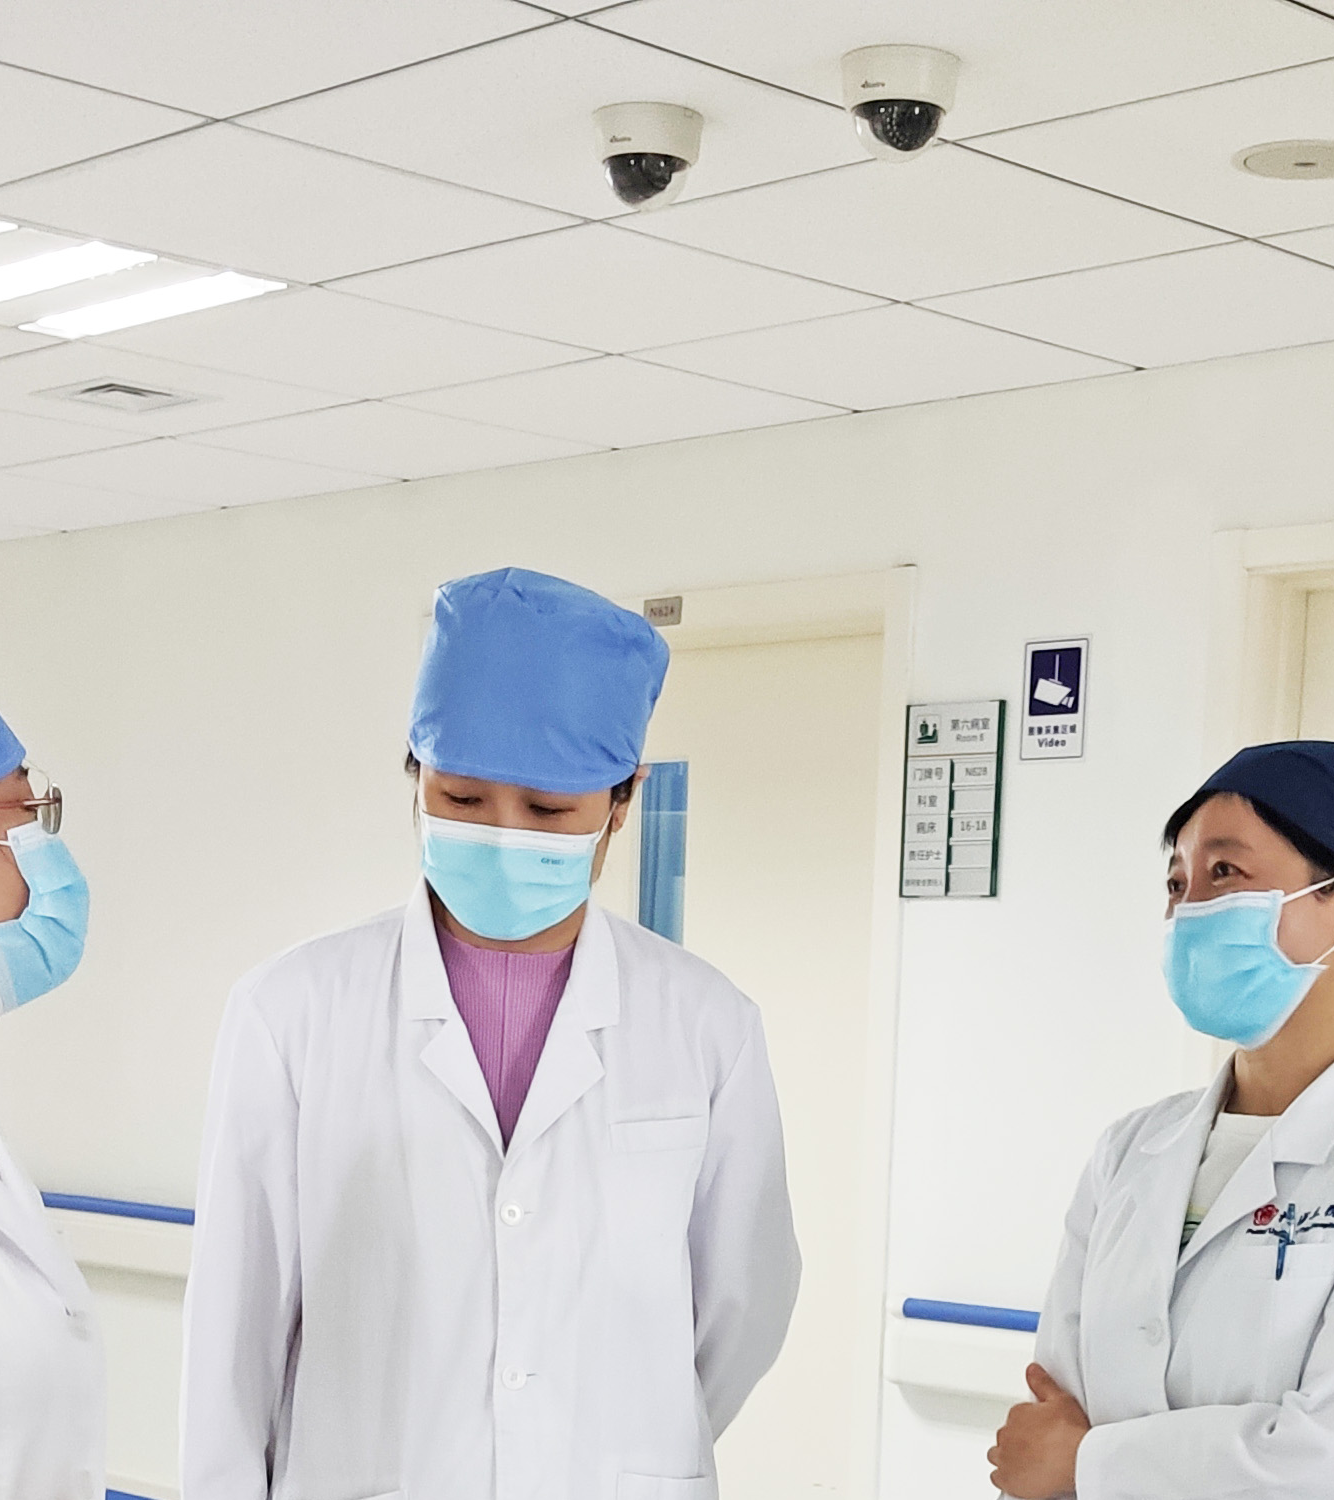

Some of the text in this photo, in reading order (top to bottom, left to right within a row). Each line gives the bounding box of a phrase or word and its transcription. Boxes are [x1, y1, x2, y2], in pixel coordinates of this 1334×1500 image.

[956, 734, 978, 742] Room
[1037, 738, 1066, 748] Video
[913, 767, 943, 781] 门牌号
[917, 795, 938, 807] 科室
